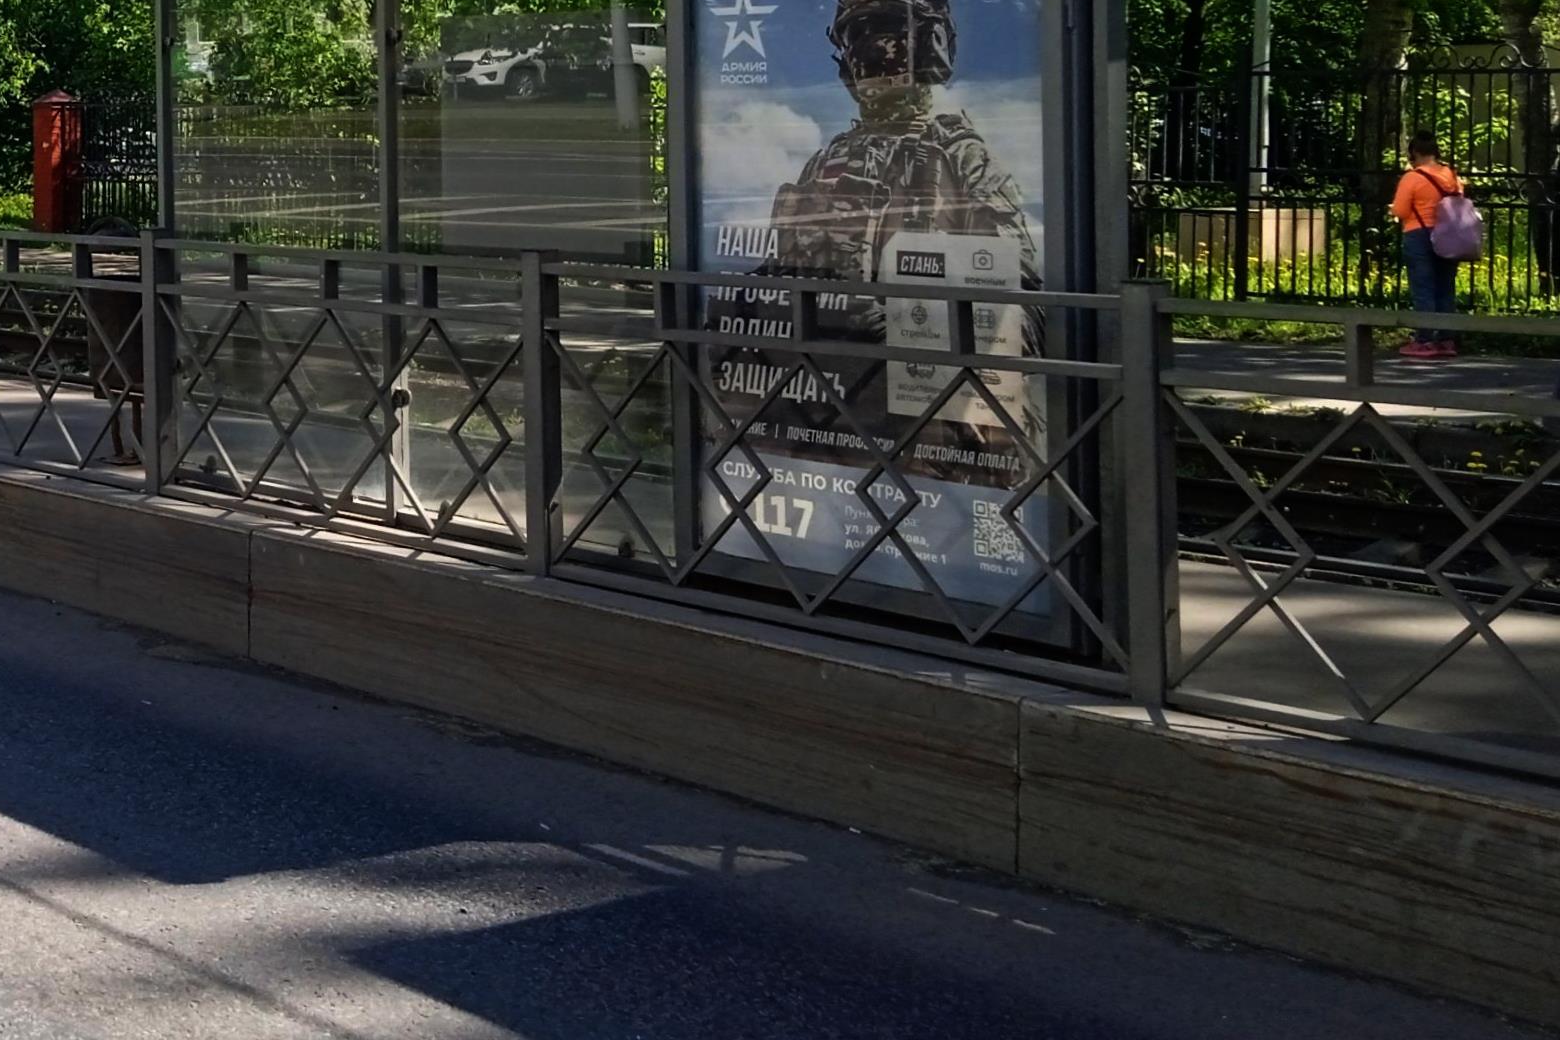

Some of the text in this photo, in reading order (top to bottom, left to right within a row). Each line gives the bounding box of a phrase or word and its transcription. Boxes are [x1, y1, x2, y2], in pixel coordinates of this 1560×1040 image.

[720, 74, 768, 84] РОССИИ
[721, 61, 767, 73] АРМИЯ
[716, 225, 779, 259] НАША
[900, 255, 944, 275] СТАНЬ:
[717, 270, 849, 311] ПРОФЕИЯ
[786, 426, 835, 446] ПОЧЕТНАЯ
[913, 443, 975, 465] ДОСТОЙНАЯ
[977, 452, 1020, 471] ОПЛАТА
[722, 461, 942, 508] СЛУБА ПО КОТРАТУ
[753, 492, 815, 540] 117
[979, 561, 1018, 576] mos.ru
